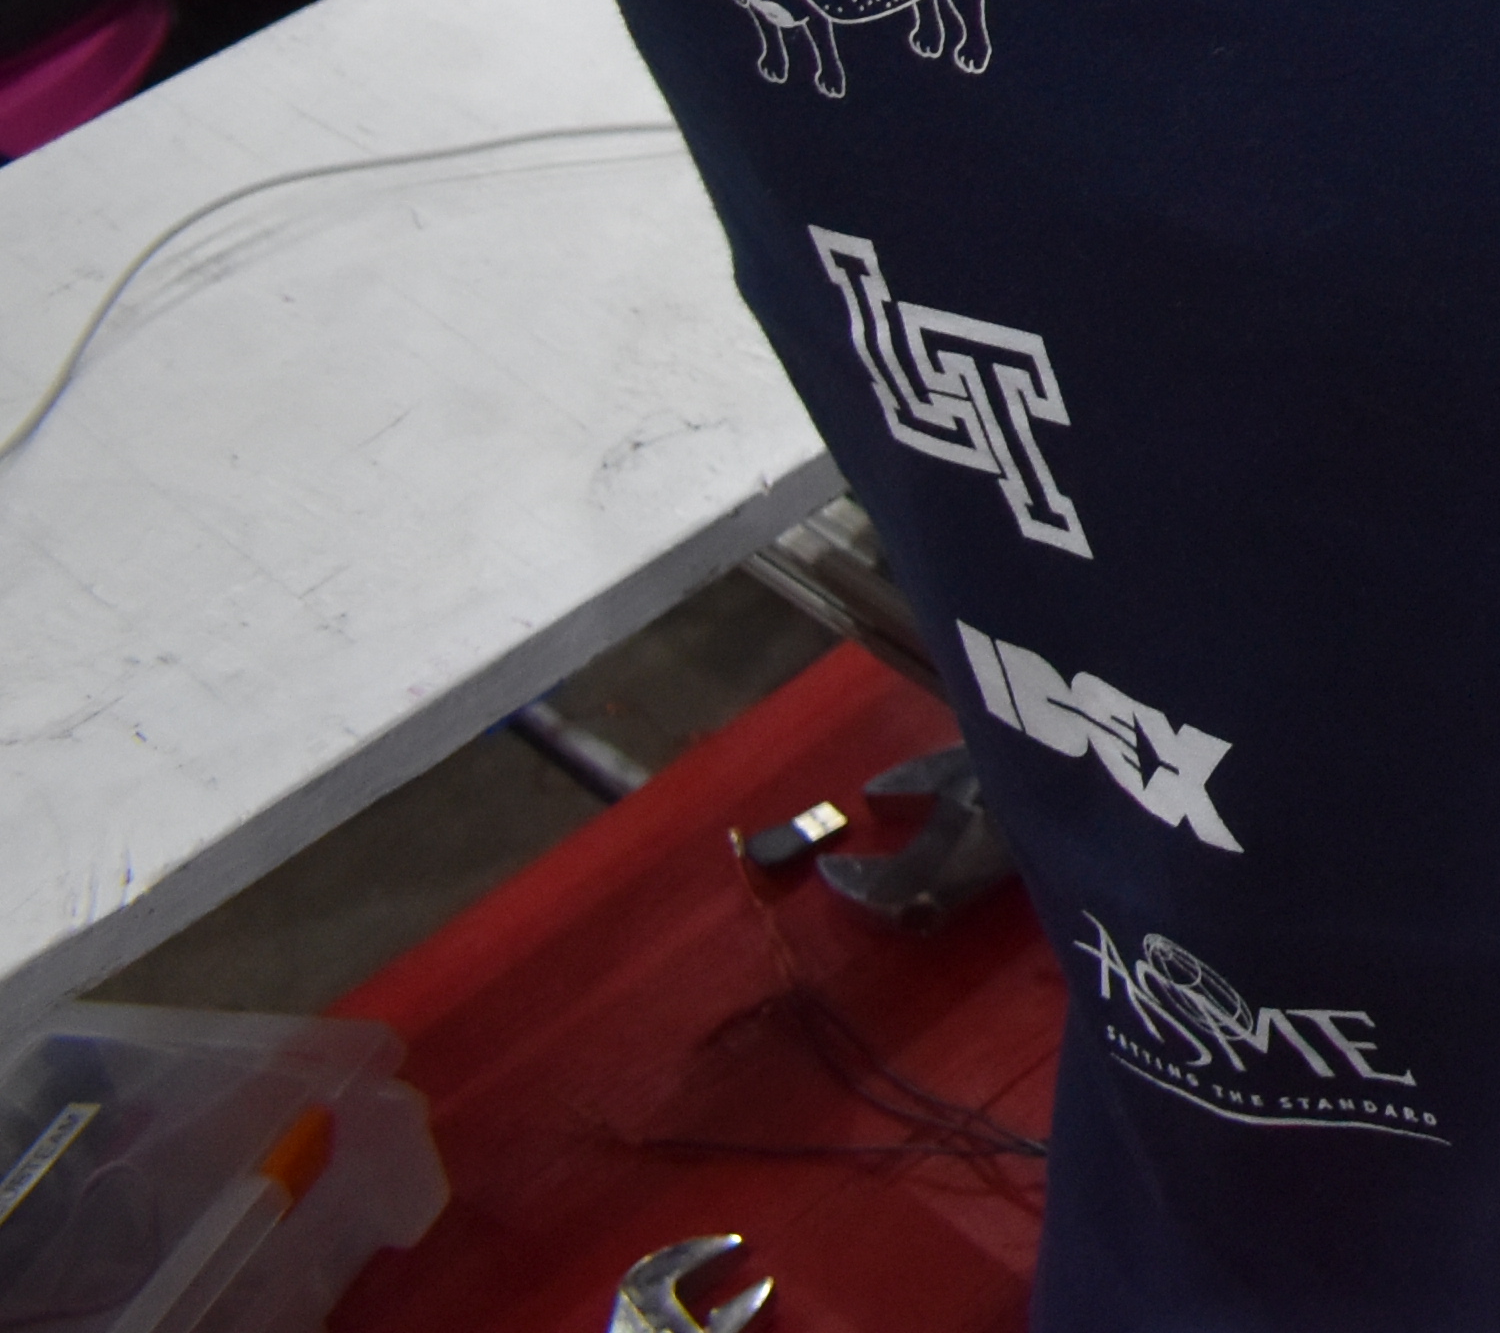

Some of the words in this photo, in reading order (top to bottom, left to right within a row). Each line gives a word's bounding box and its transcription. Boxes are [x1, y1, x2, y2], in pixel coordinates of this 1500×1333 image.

[955, 617, 1245, 853] IDEX
[1074, 910, 1416, 1086] ASME
[1106, 1024, 1200, 1087] SETTING
[1212, 1084, 1265, 1108] THE
[1279, 1096, 1438, 1127] STANDARD
